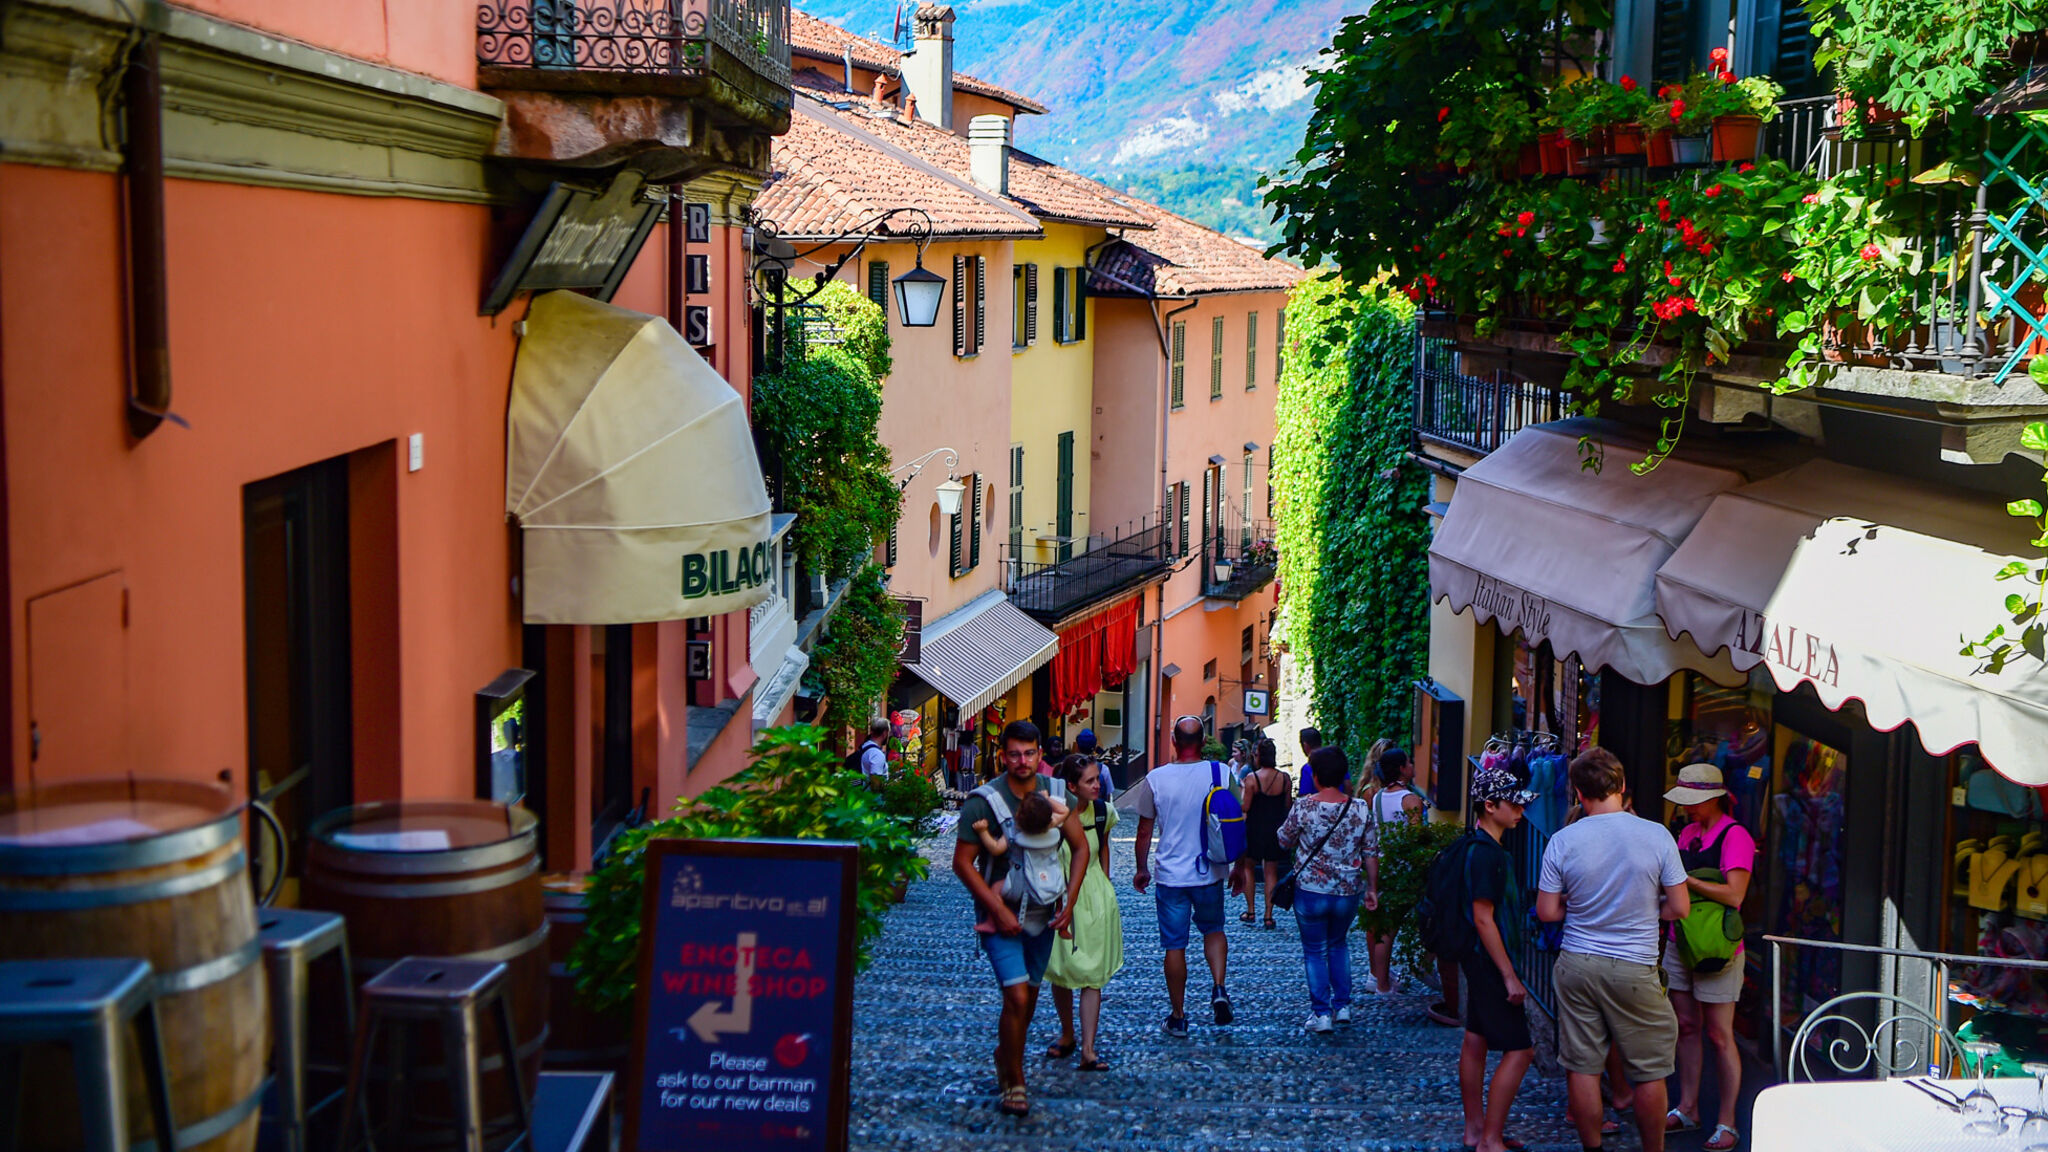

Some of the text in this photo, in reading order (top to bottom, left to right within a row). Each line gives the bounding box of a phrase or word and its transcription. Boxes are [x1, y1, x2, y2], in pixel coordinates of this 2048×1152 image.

[1472, 574, 1551, 641] Italian Style
[1733, 609, 1838, 688] AZALEA
[680, 943, 812, 970] ENOTECA
[662, 971, 827, 999] WINE SHOP
[709, 1051, 768, 1071] Please
[656, 1069, 816, 1093] ask to our barman
[659, 1089, 811, 1113] for our new deals
